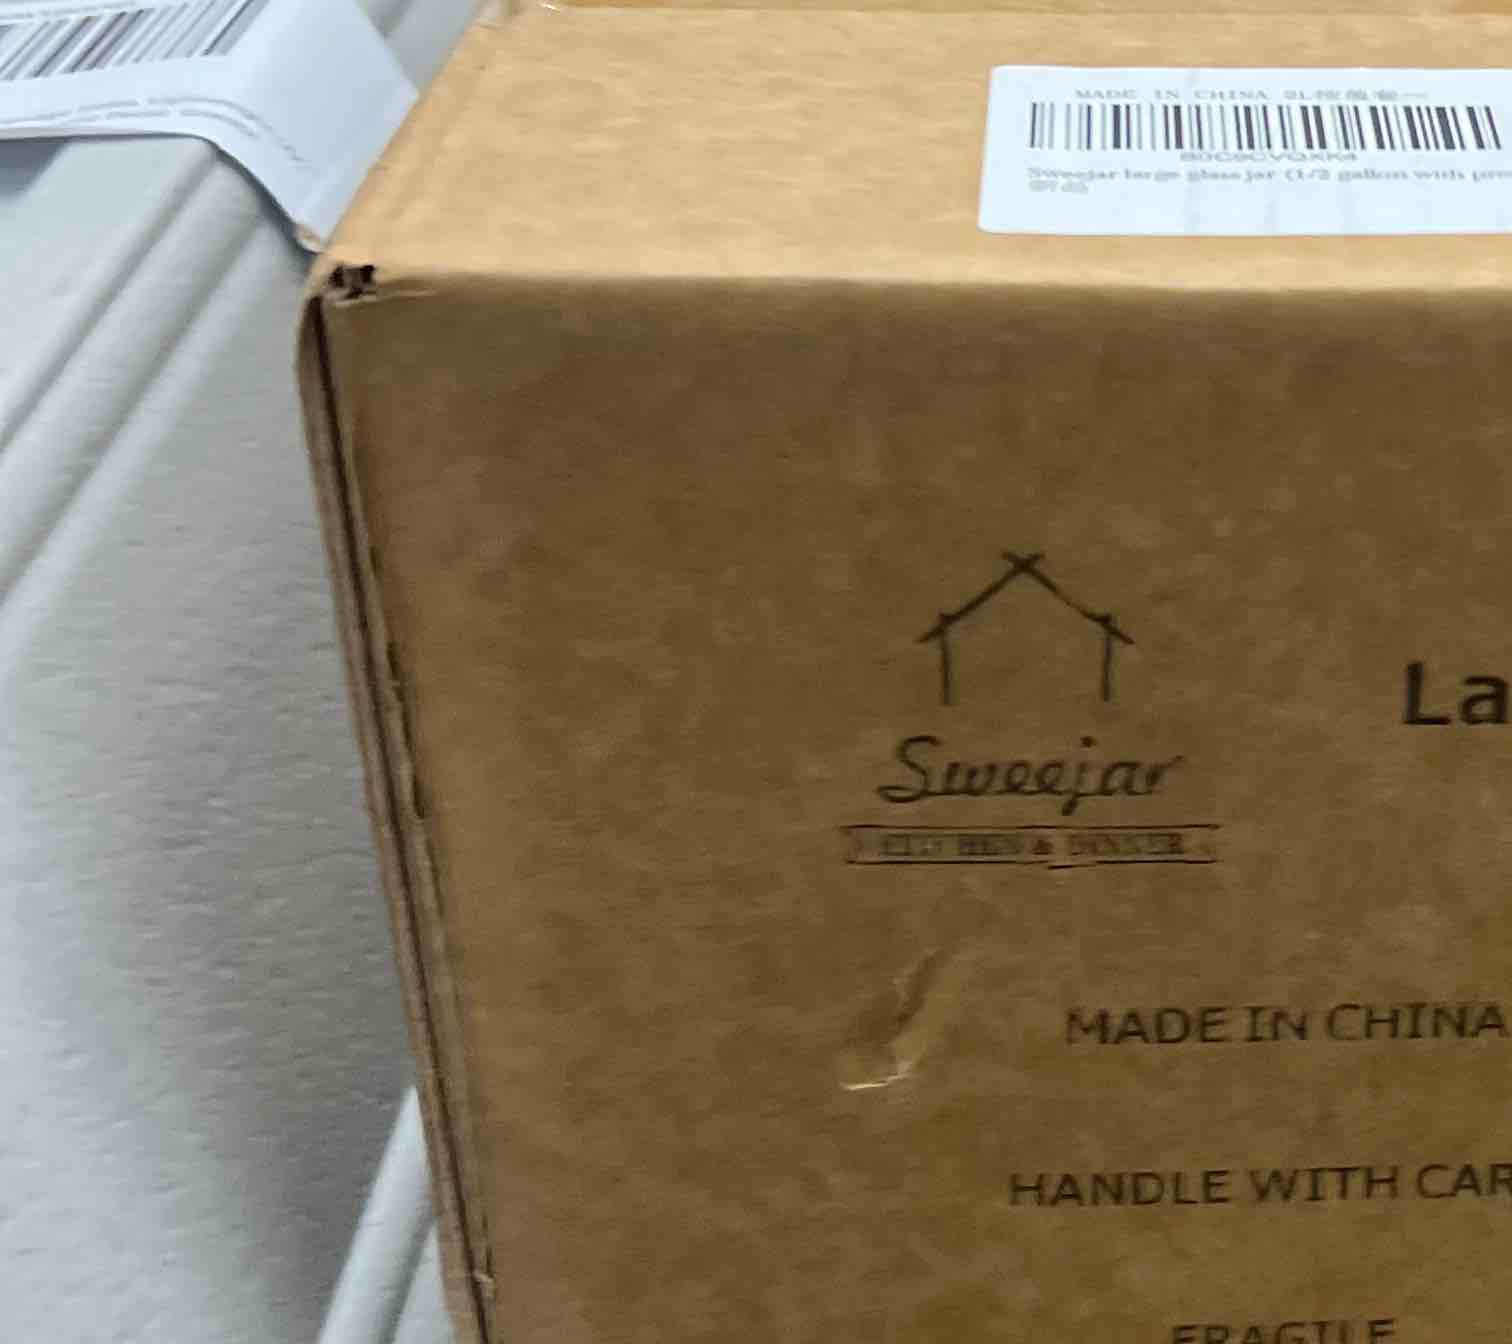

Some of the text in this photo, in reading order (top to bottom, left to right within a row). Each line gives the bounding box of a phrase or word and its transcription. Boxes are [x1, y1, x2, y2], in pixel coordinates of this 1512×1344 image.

[1075, 88, 1138, 100] MADE
[1154, 88, 1180, 100] IN
[1194, 88, 1271, 101] CHINA
[876, 735, 1188, 817] Sweejar
[1065, 1001, 1511, 1045] MADE IN CHINA
[1009, 1168, 1231, 1208] HANDLE
[1247, 1165, 1401, 1203] WITH
